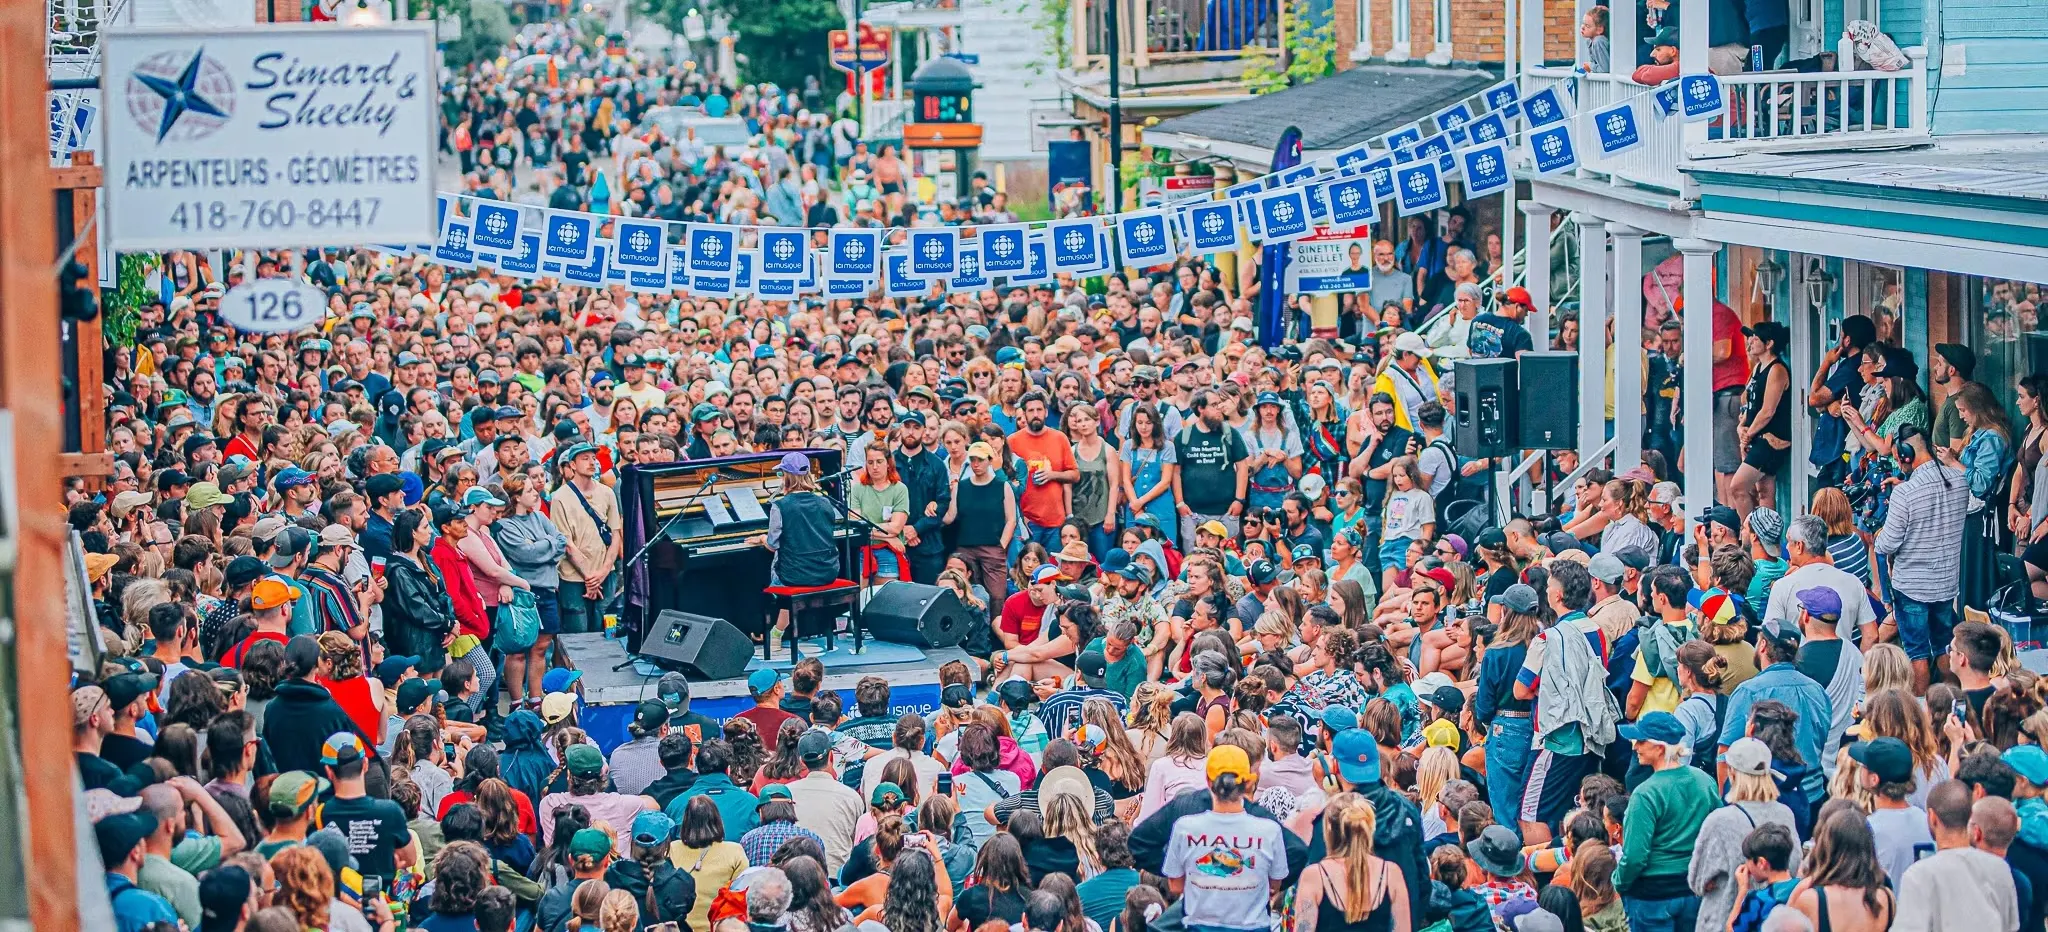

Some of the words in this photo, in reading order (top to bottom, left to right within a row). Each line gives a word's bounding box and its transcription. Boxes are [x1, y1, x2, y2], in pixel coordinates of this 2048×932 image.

[246, 50, 401, 90] Simard
[397, 72, 418, 99] &
[258, 88, 398, 136] Sheehy
[125, 156, 269, 188] ARPENTEURS
[287, 150, 418, 185] GÉOMÈTRES
[169, 197, 383, 233] 418-760-8447
[1298, 244, 1341, 254] GINETTE
[1298, 254, 1343, 263] OUELLET
[246, 290, 303, 321] 126
[1187, 834, 1262, 850] MAUI
